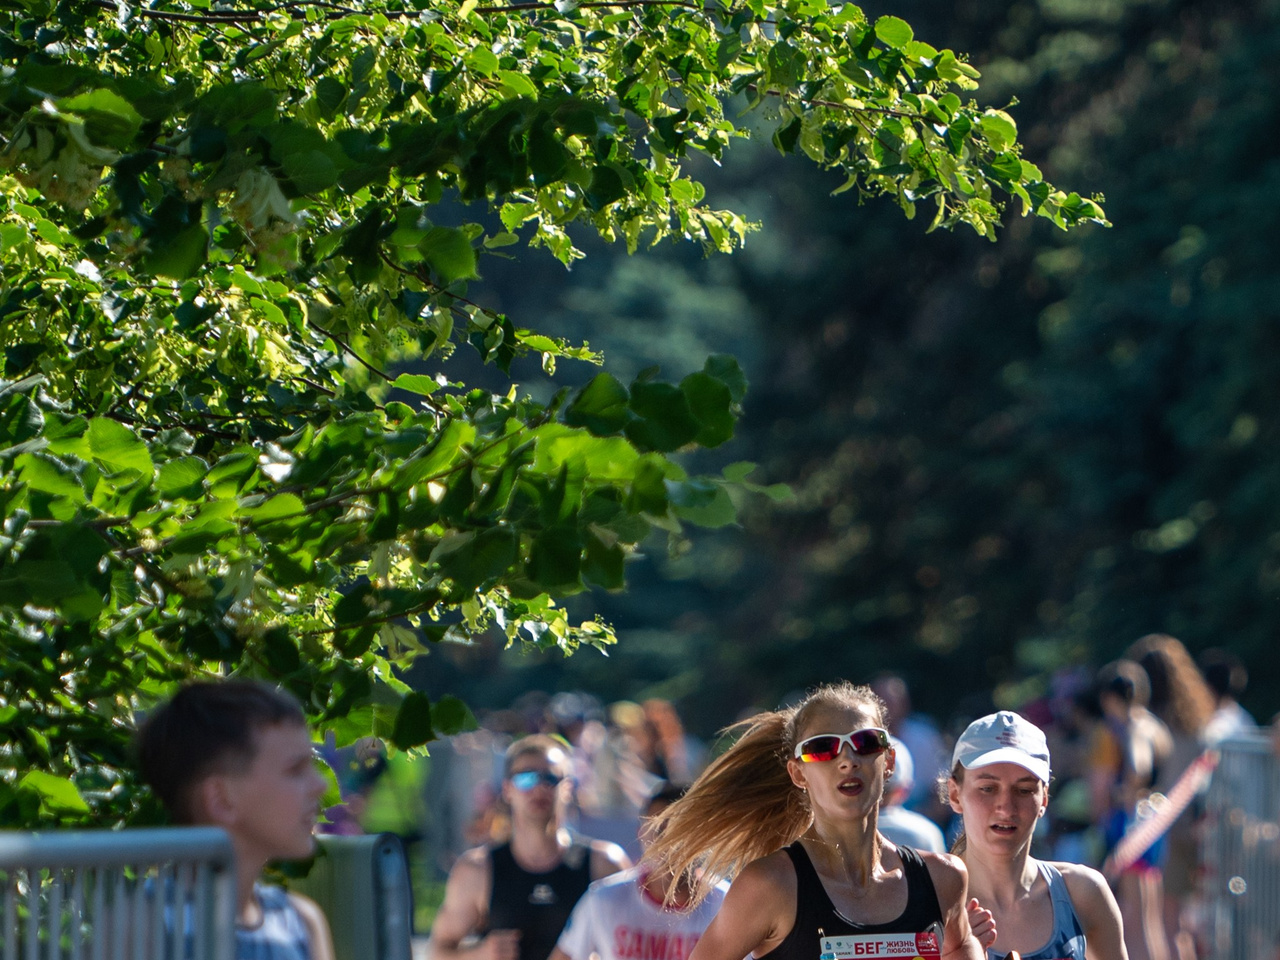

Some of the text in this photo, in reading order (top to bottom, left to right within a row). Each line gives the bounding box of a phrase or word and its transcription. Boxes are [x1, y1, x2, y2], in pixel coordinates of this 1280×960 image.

[886, 940, 915, 948] ЖИЗНЬ
[854, 942, 883, 955] БЕГ
[886, 947, 916, 955] ЛЮБОВЬ
